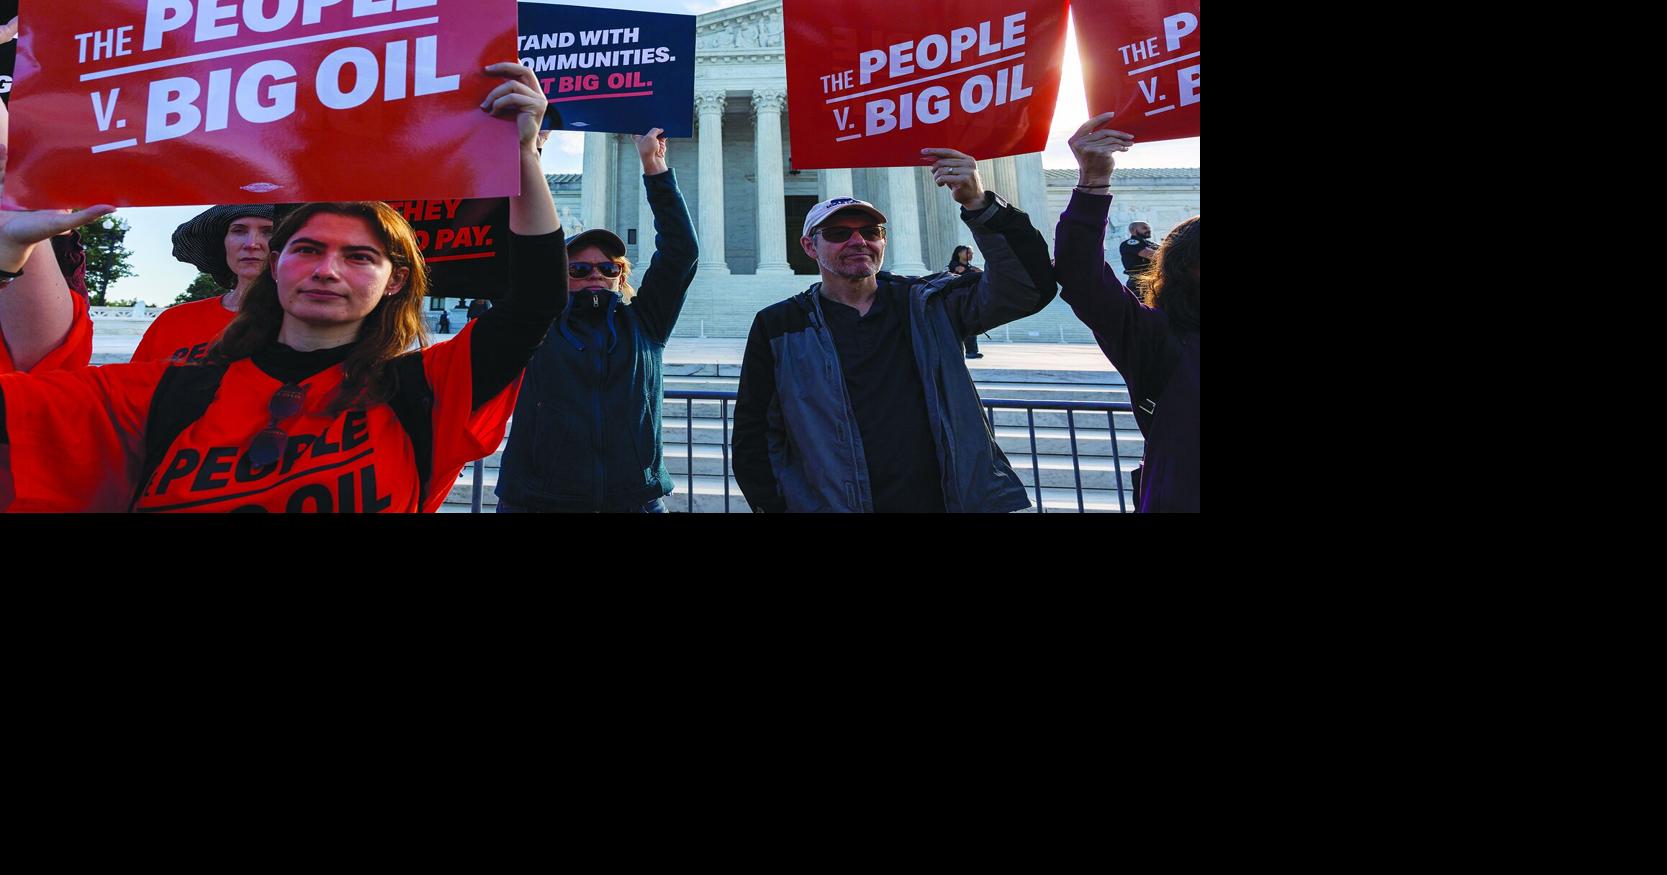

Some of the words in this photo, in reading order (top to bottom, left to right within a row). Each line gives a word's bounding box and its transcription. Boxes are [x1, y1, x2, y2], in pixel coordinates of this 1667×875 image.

[74, 25, 133, 64] THE
[579, 27, 640, 48] WITH
[1118, 36, 1160, 65] THE
[820, 69, 855, 94] THE
[859, 11, 1027, 86] PEOPLE
[90, 88, 127, 132] V.
[145, 59, 298, 144] BIG
[315, 35, 461, 110] OIL
[558, 74, 600, 93] BIG
[607, 71, 653, 89] OIL.
[1138, 76, 1167, 104] V.
[833, 106, 855, 132] V.
[865, 85, 951, 137] BIG
[960, 63, 1033, 114] OIL
[434, 225, 494, 250] PAY.
